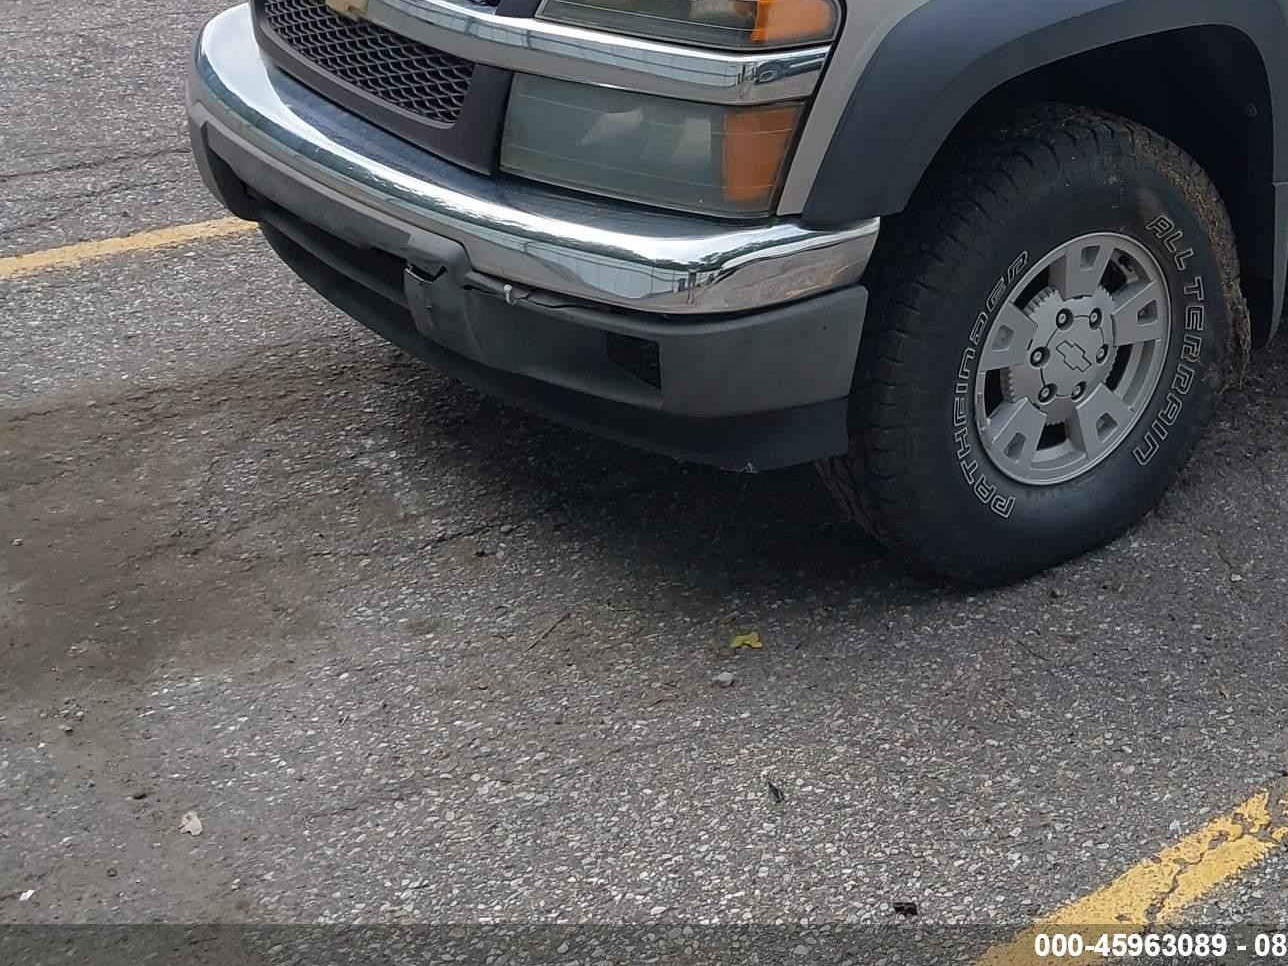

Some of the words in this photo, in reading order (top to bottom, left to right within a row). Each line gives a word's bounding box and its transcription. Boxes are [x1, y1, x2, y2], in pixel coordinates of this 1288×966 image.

[1145, 215, 1194, 272] ALL
[953, 250, 1029, 519] PATHFINDER
[1132, 276, 1205, 466] TERRAIN
